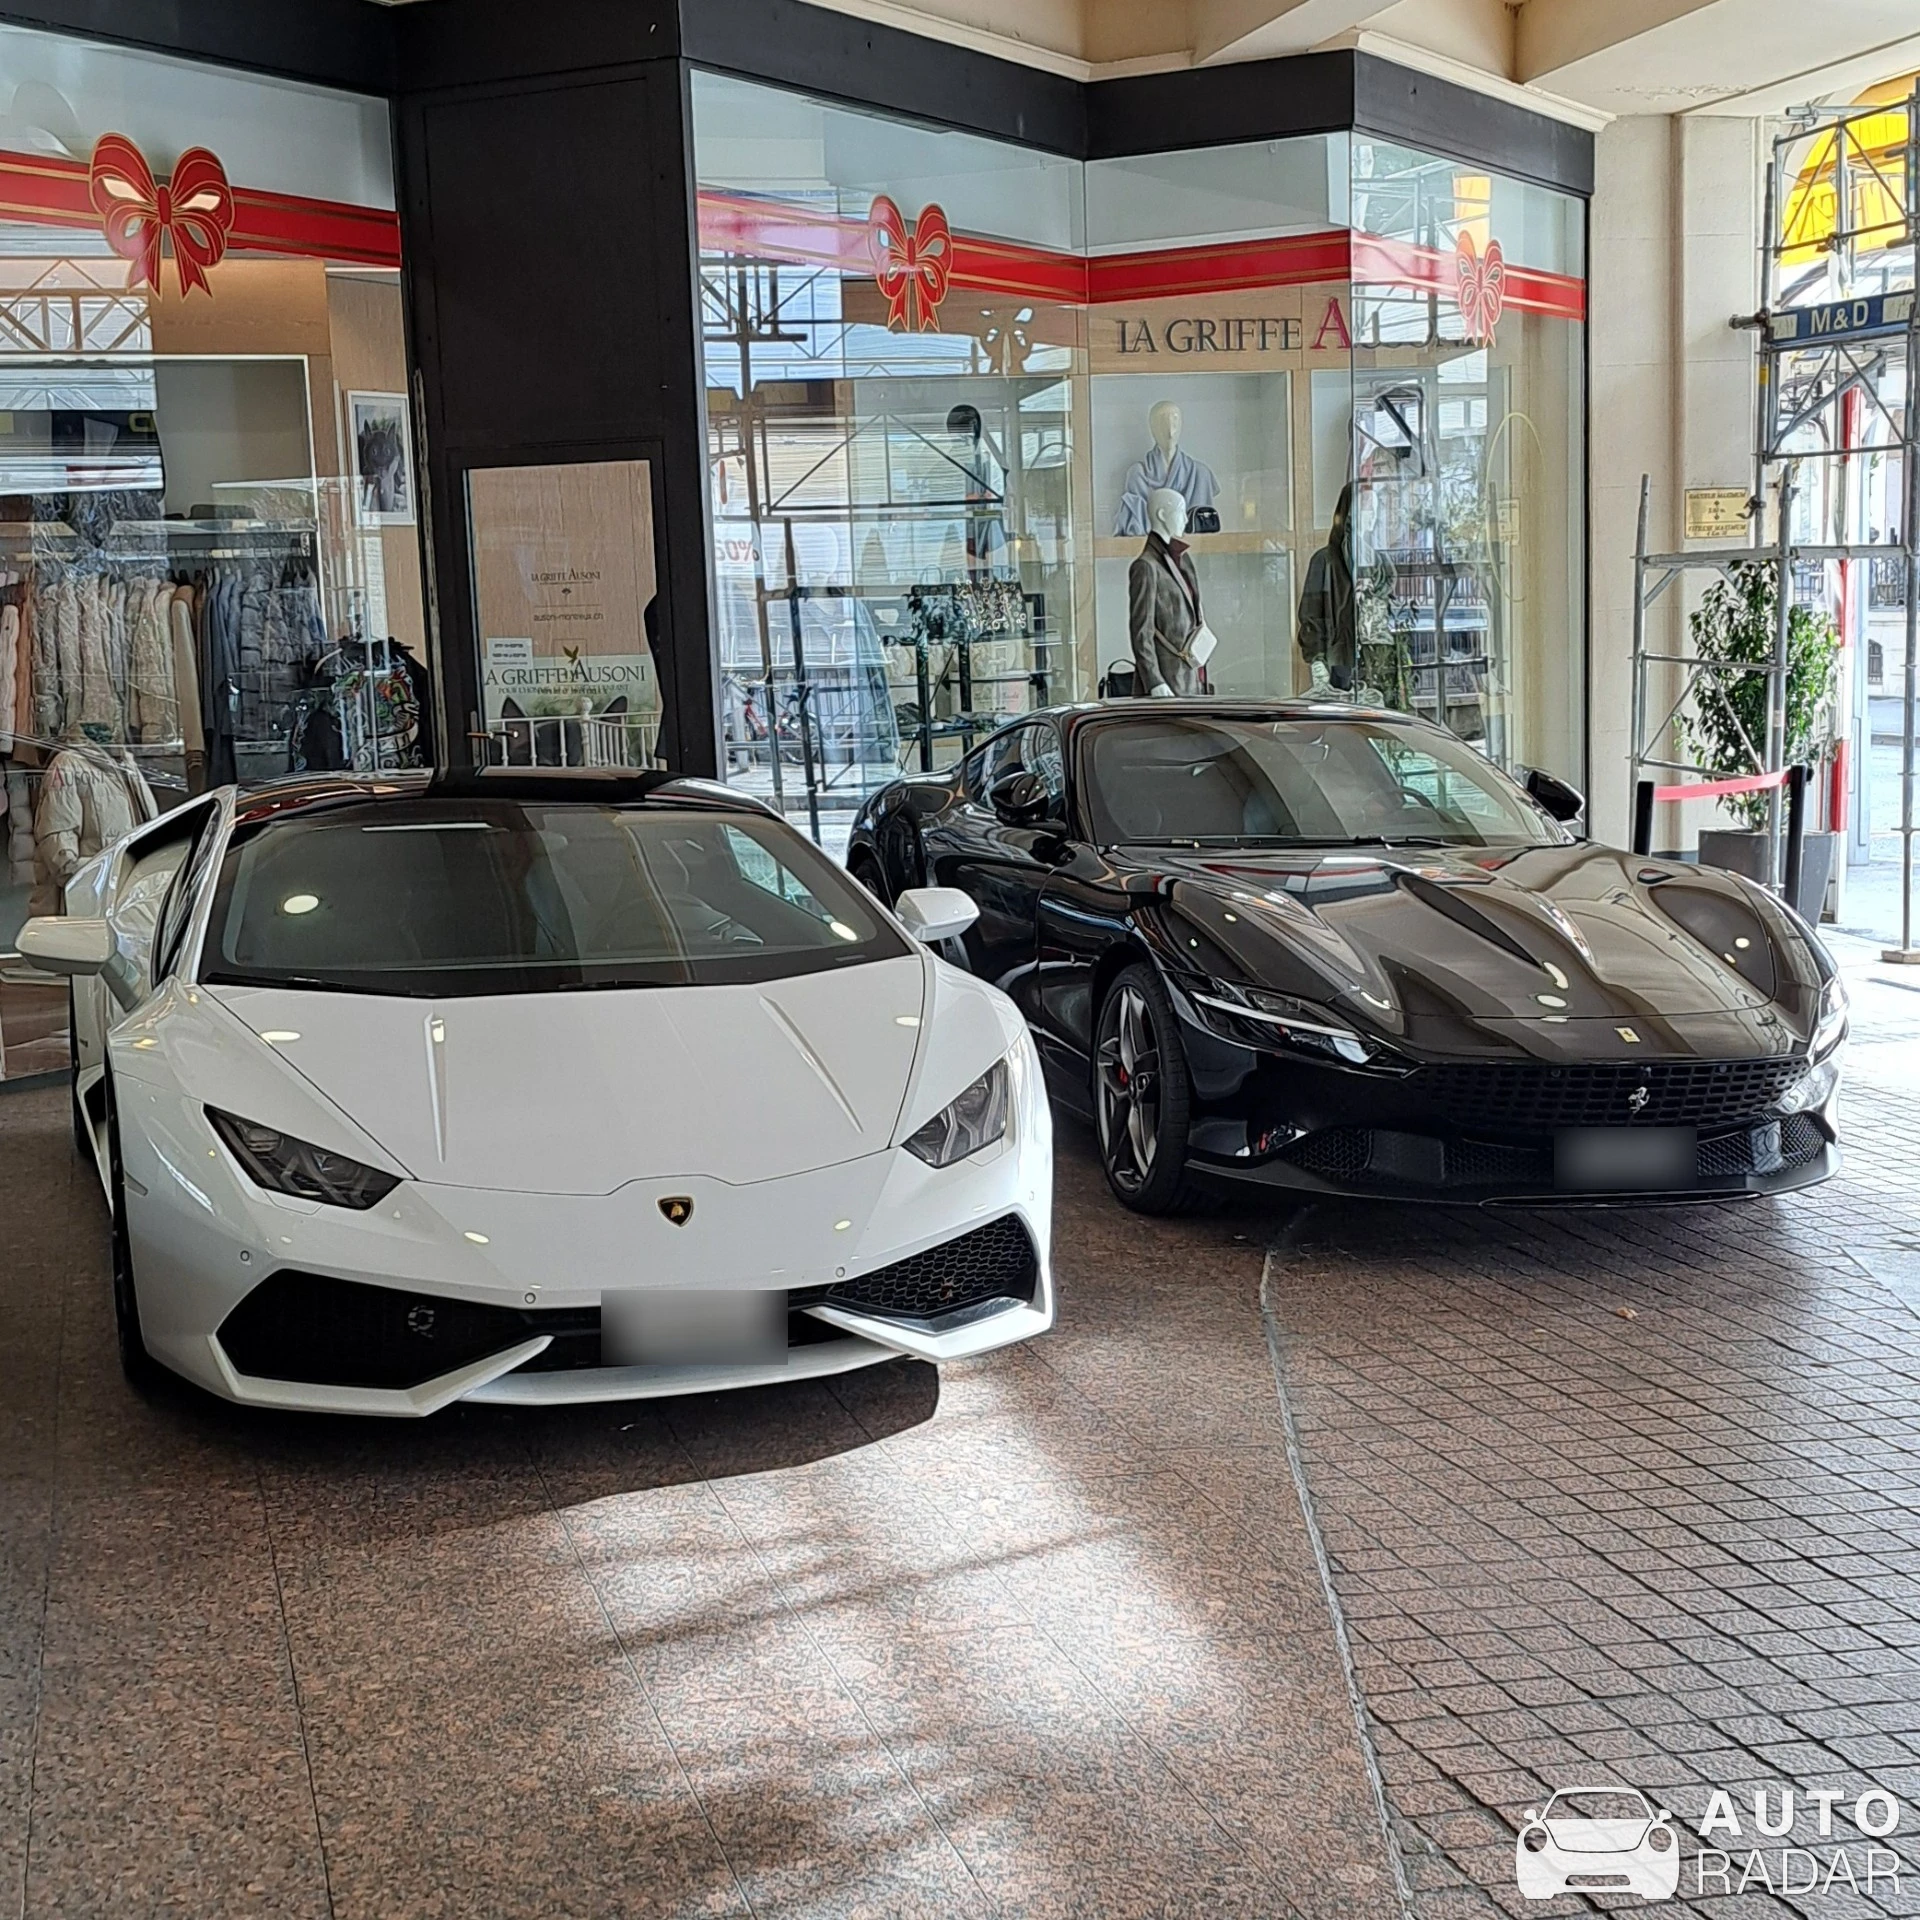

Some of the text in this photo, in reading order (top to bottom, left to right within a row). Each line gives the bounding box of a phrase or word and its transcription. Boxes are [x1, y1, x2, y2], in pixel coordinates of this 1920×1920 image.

[1810, 300, 1869, 335] M&D
[1117, 319, 1158, 354] LA
[1165, 317, 1302, 352] GRIFFE
[571, 659, 646, 684] AUSONI
